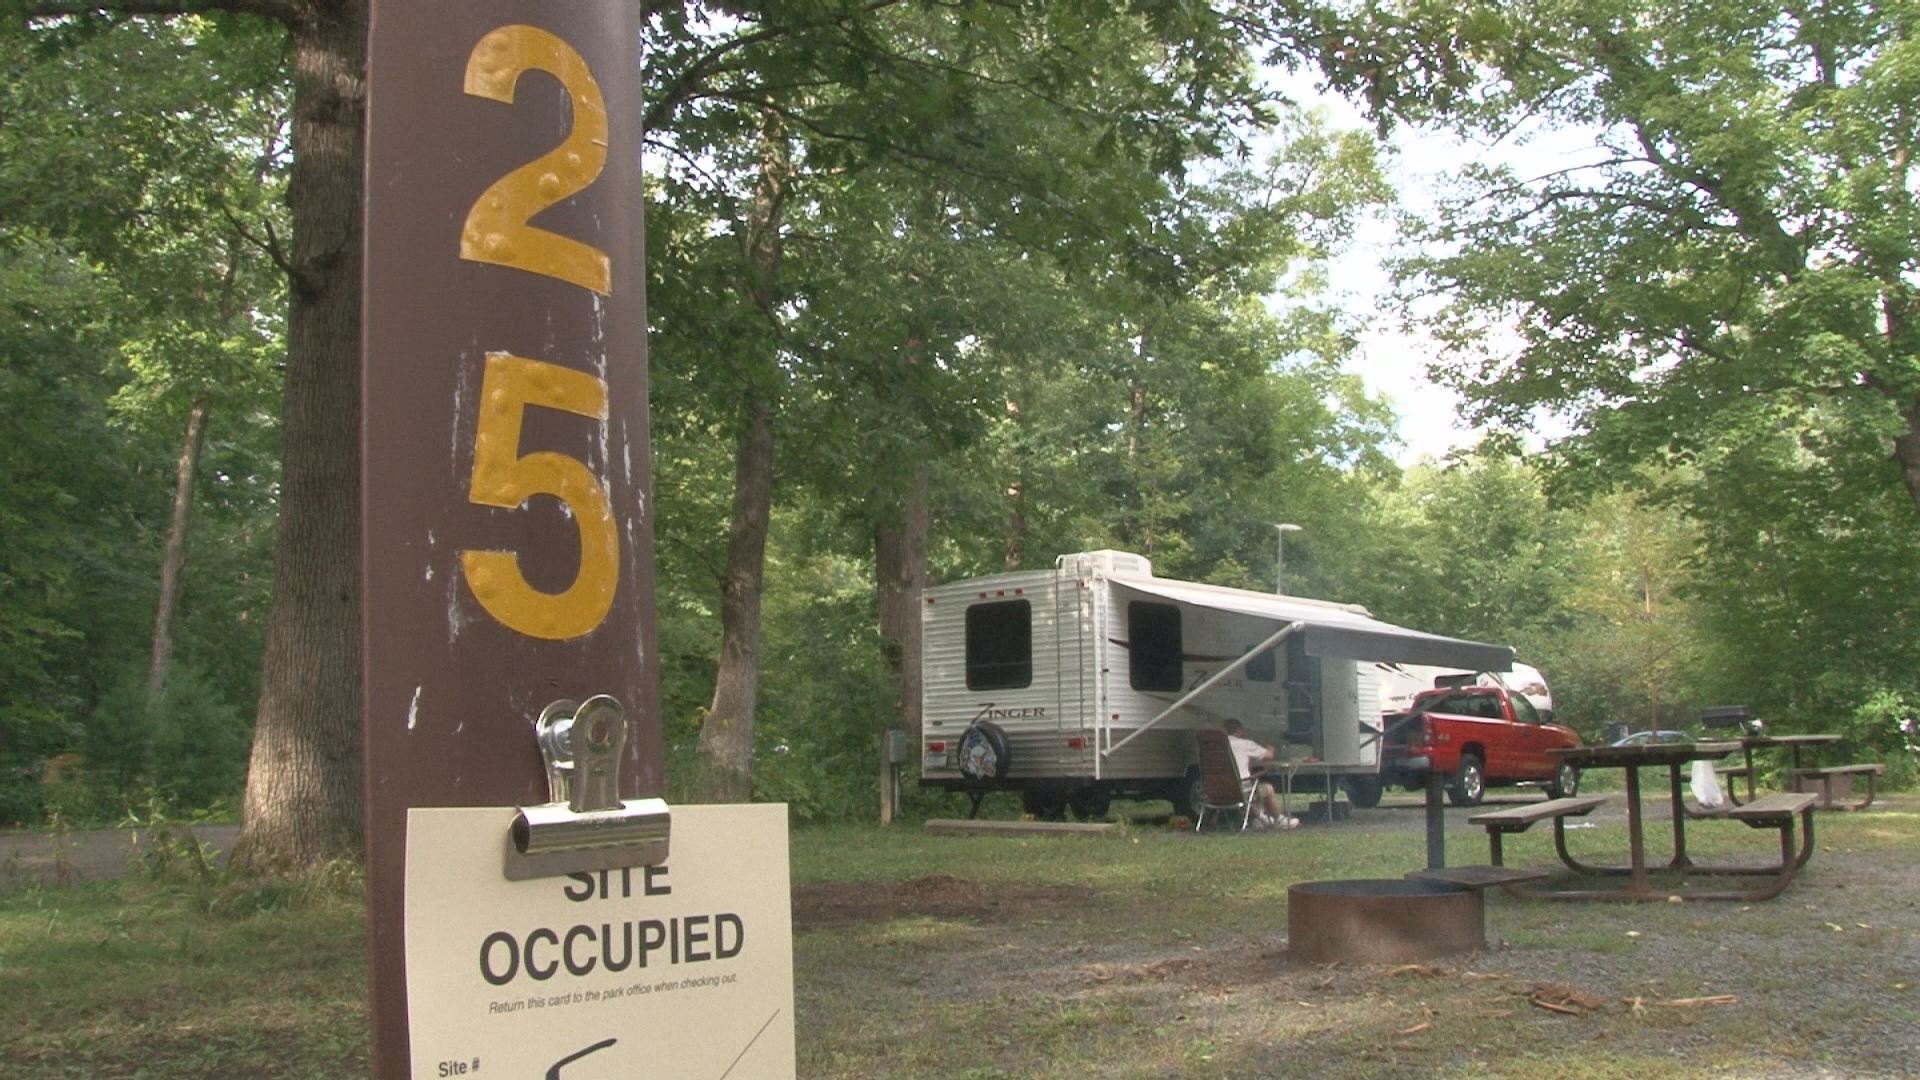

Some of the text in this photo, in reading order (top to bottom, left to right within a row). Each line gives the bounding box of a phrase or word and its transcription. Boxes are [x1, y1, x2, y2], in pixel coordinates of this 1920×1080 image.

[460, 24, 620, 640] 25
[971, 703, 1046, 725] ZINGER
[479, 912, 745, 986] OCCUPIED
[489, 1001, 525, 1014] Return
[527, 997, 545, 1009] this
[548, 992, 571, 1005] card
[572, 993, 583, 1003] to
[584, 991, 601, 1002] the
[602, 987, 624, 1001] park
[626, 983, 652, 996] office
[654, 981, 679, 993] when
[680, 975, 720, 988] checking
[438, 1056, 481, 1078] Site #
